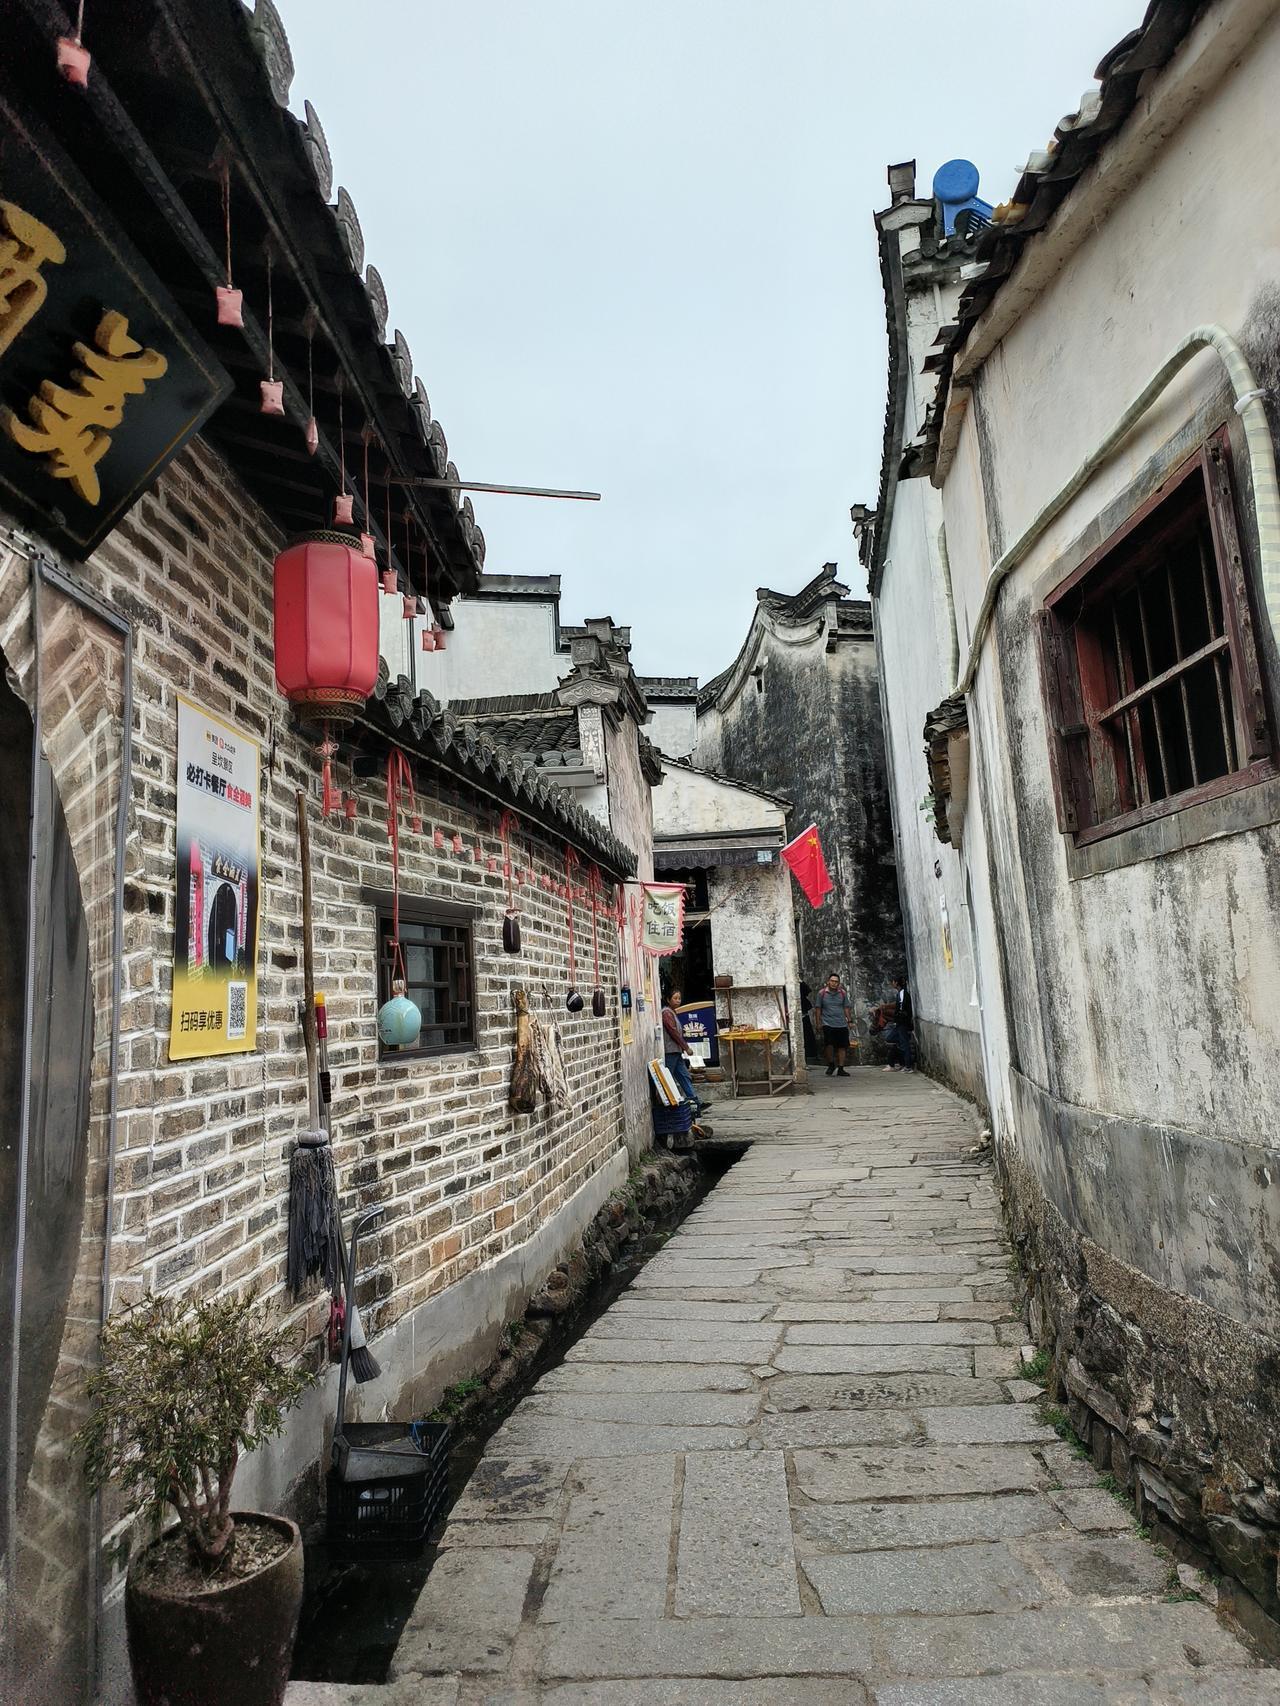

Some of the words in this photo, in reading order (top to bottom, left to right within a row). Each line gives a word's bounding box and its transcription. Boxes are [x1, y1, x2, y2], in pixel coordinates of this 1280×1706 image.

[648, 901, 676, 917] 吃饭
[646, 921, 676, 937] 住宿
[180, 1010, 223, 1033] 扫码享优惠
